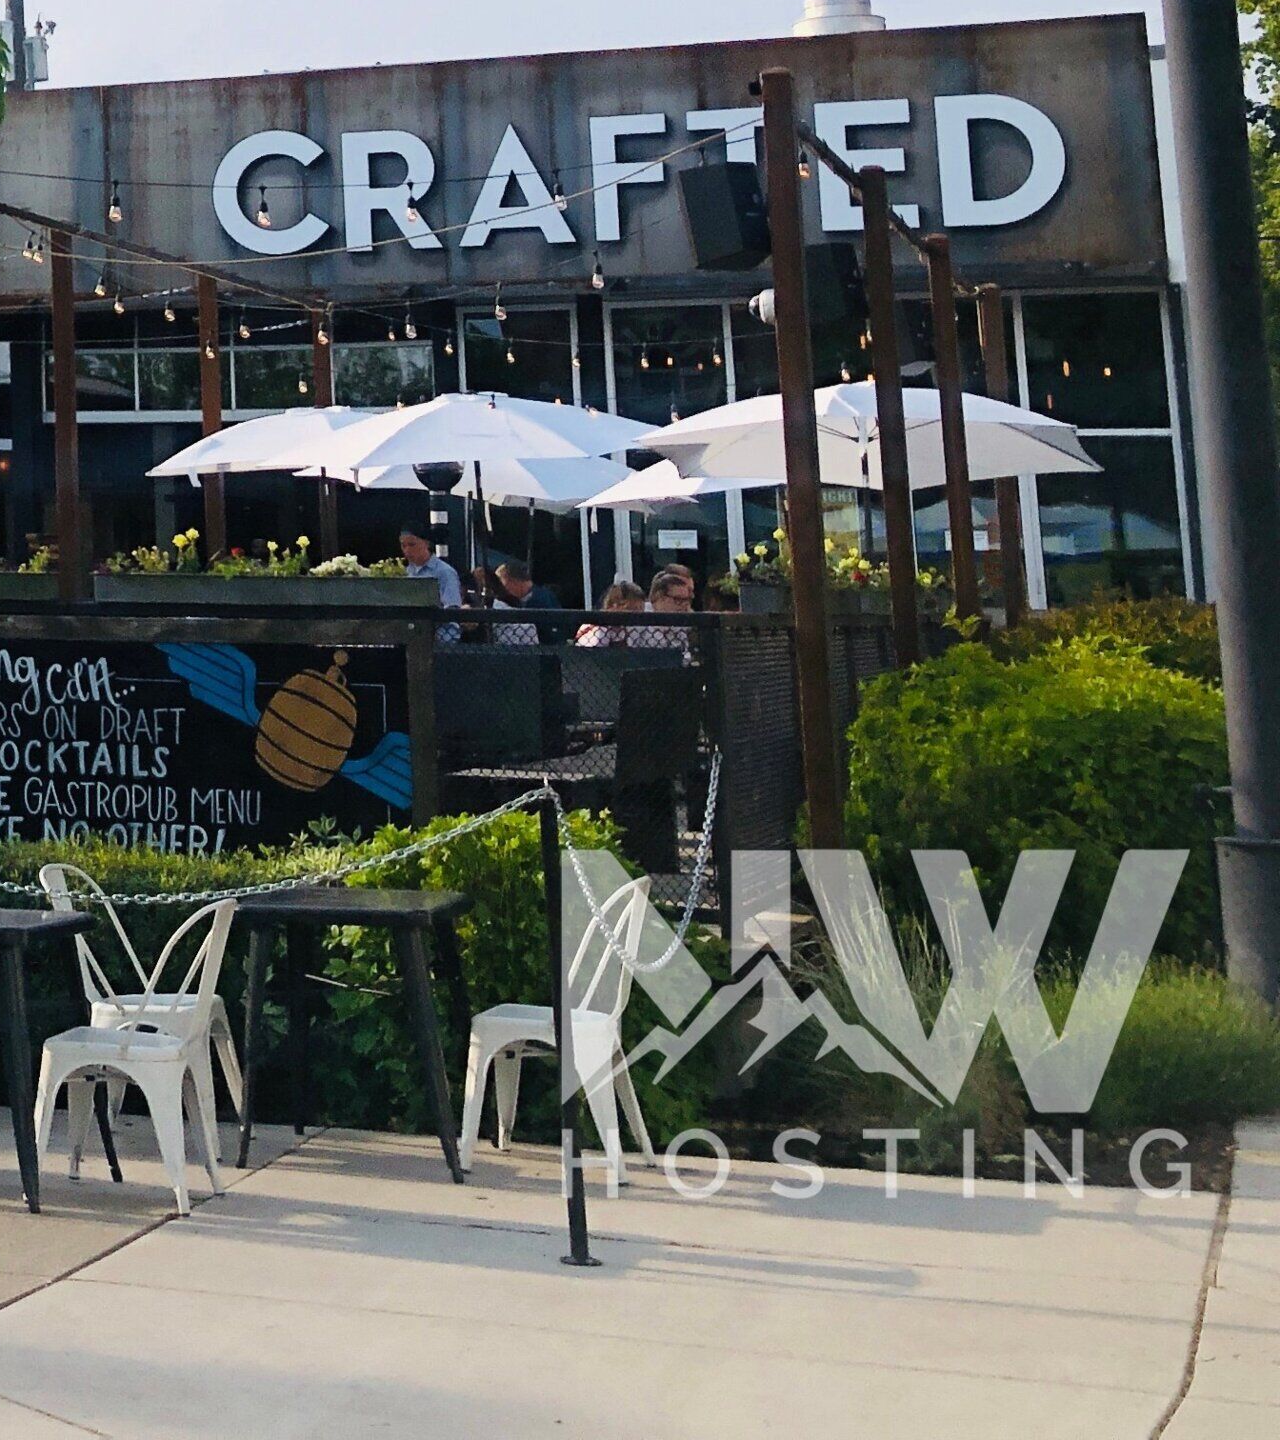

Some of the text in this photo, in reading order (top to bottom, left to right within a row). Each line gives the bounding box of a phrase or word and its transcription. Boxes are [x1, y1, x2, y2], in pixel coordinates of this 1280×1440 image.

[212, 94, 1067, 256] CRAFTED
[42, 705, 79, 741] ON
[100, 706, 186, 745] DRAFT
[23, 778, 179, 819] GASTROPUB
[190, 788, 262, 826] MENU
[43, 818, 90, 844] NO
